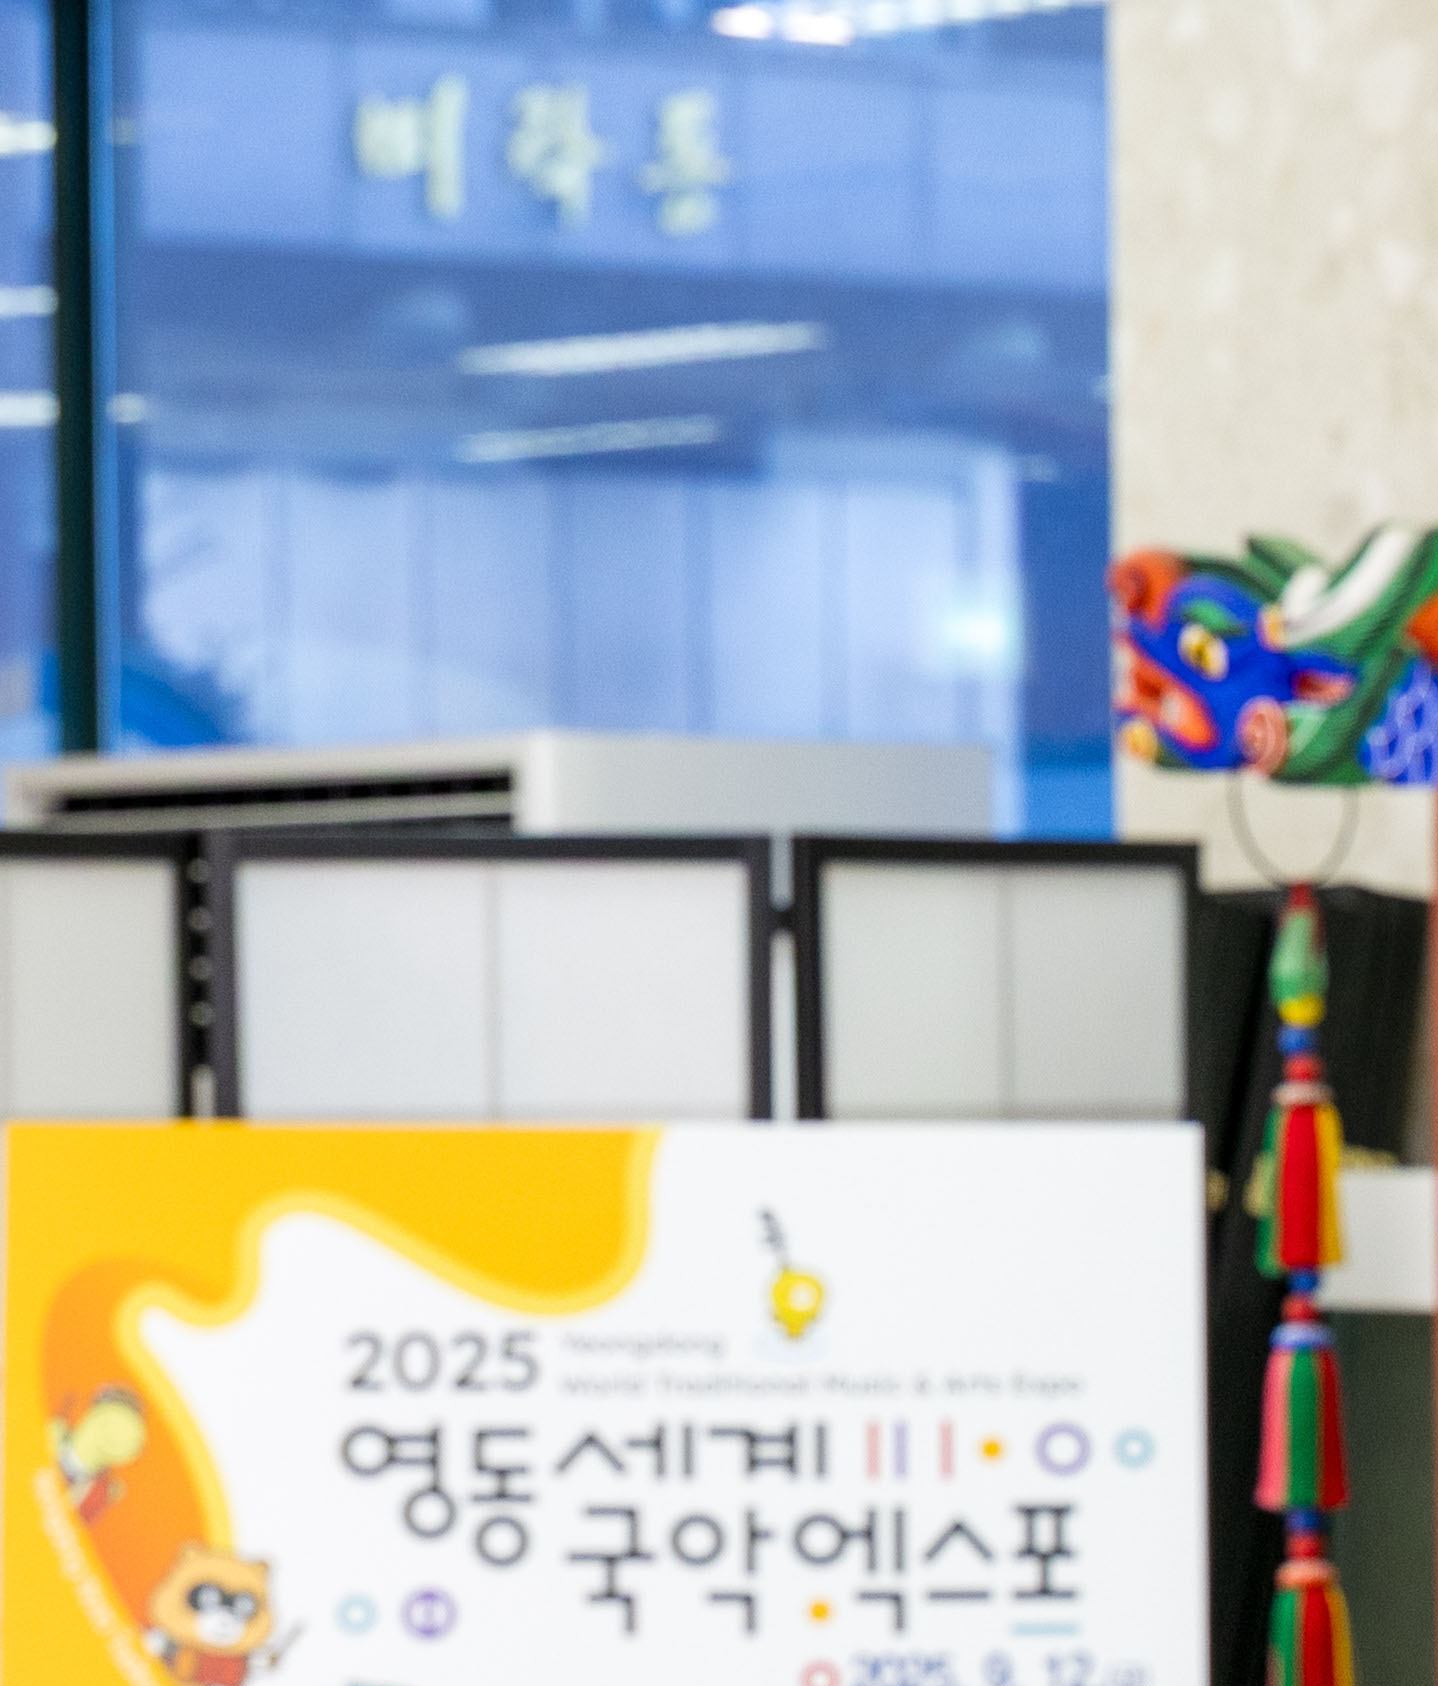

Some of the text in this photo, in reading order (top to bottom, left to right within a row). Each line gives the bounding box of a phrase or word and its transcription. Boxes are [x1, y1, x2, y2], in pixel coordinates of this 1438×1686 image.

[350, 1333, 538, 1391] 2025
[341, 1423, 829, 1567] 영동세계
[567, 1503, 1080, 1634] 국악엑스포
